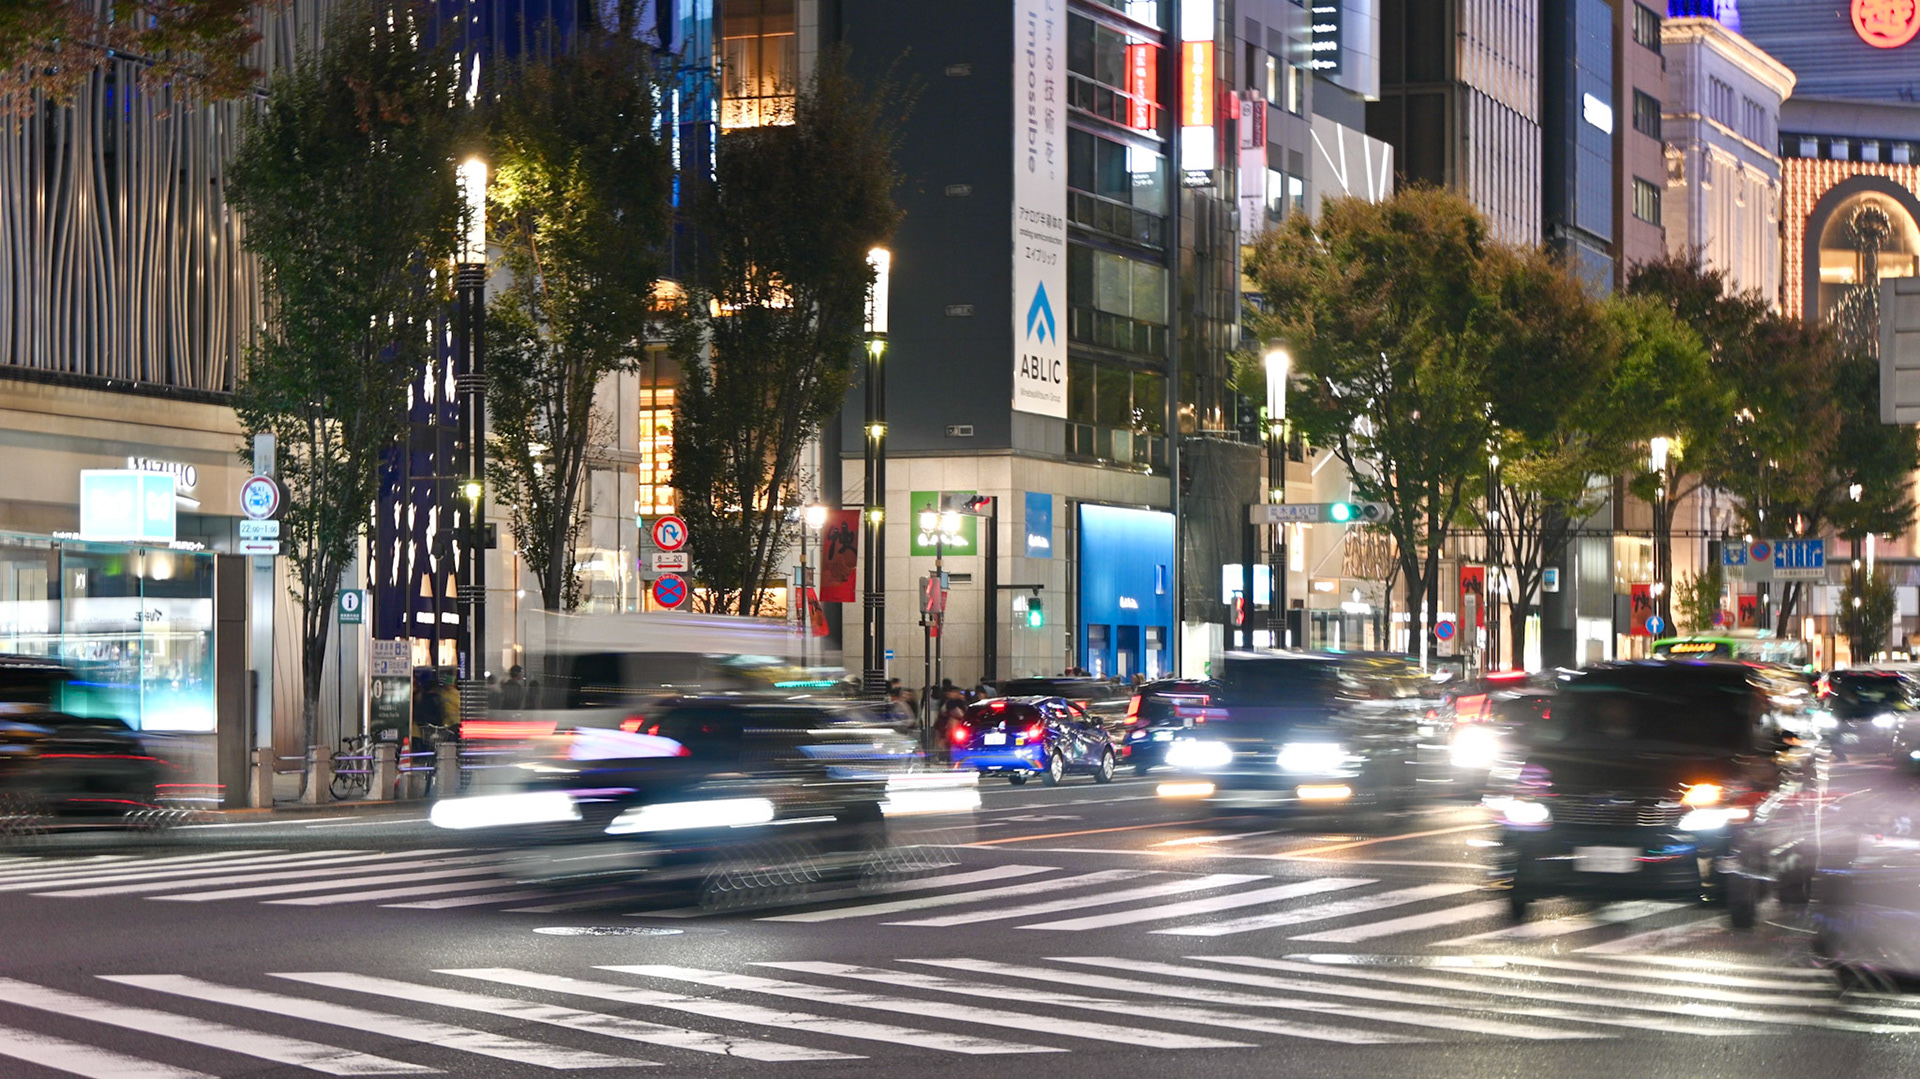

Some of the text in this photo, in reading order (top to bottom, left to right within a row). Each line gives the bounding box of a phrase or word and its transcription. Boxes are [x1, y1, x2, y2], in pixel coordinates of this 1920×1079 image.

[1025, 246, 1057, 266] エイブリック
[1020, 354, 1061, 384] ABLIC
